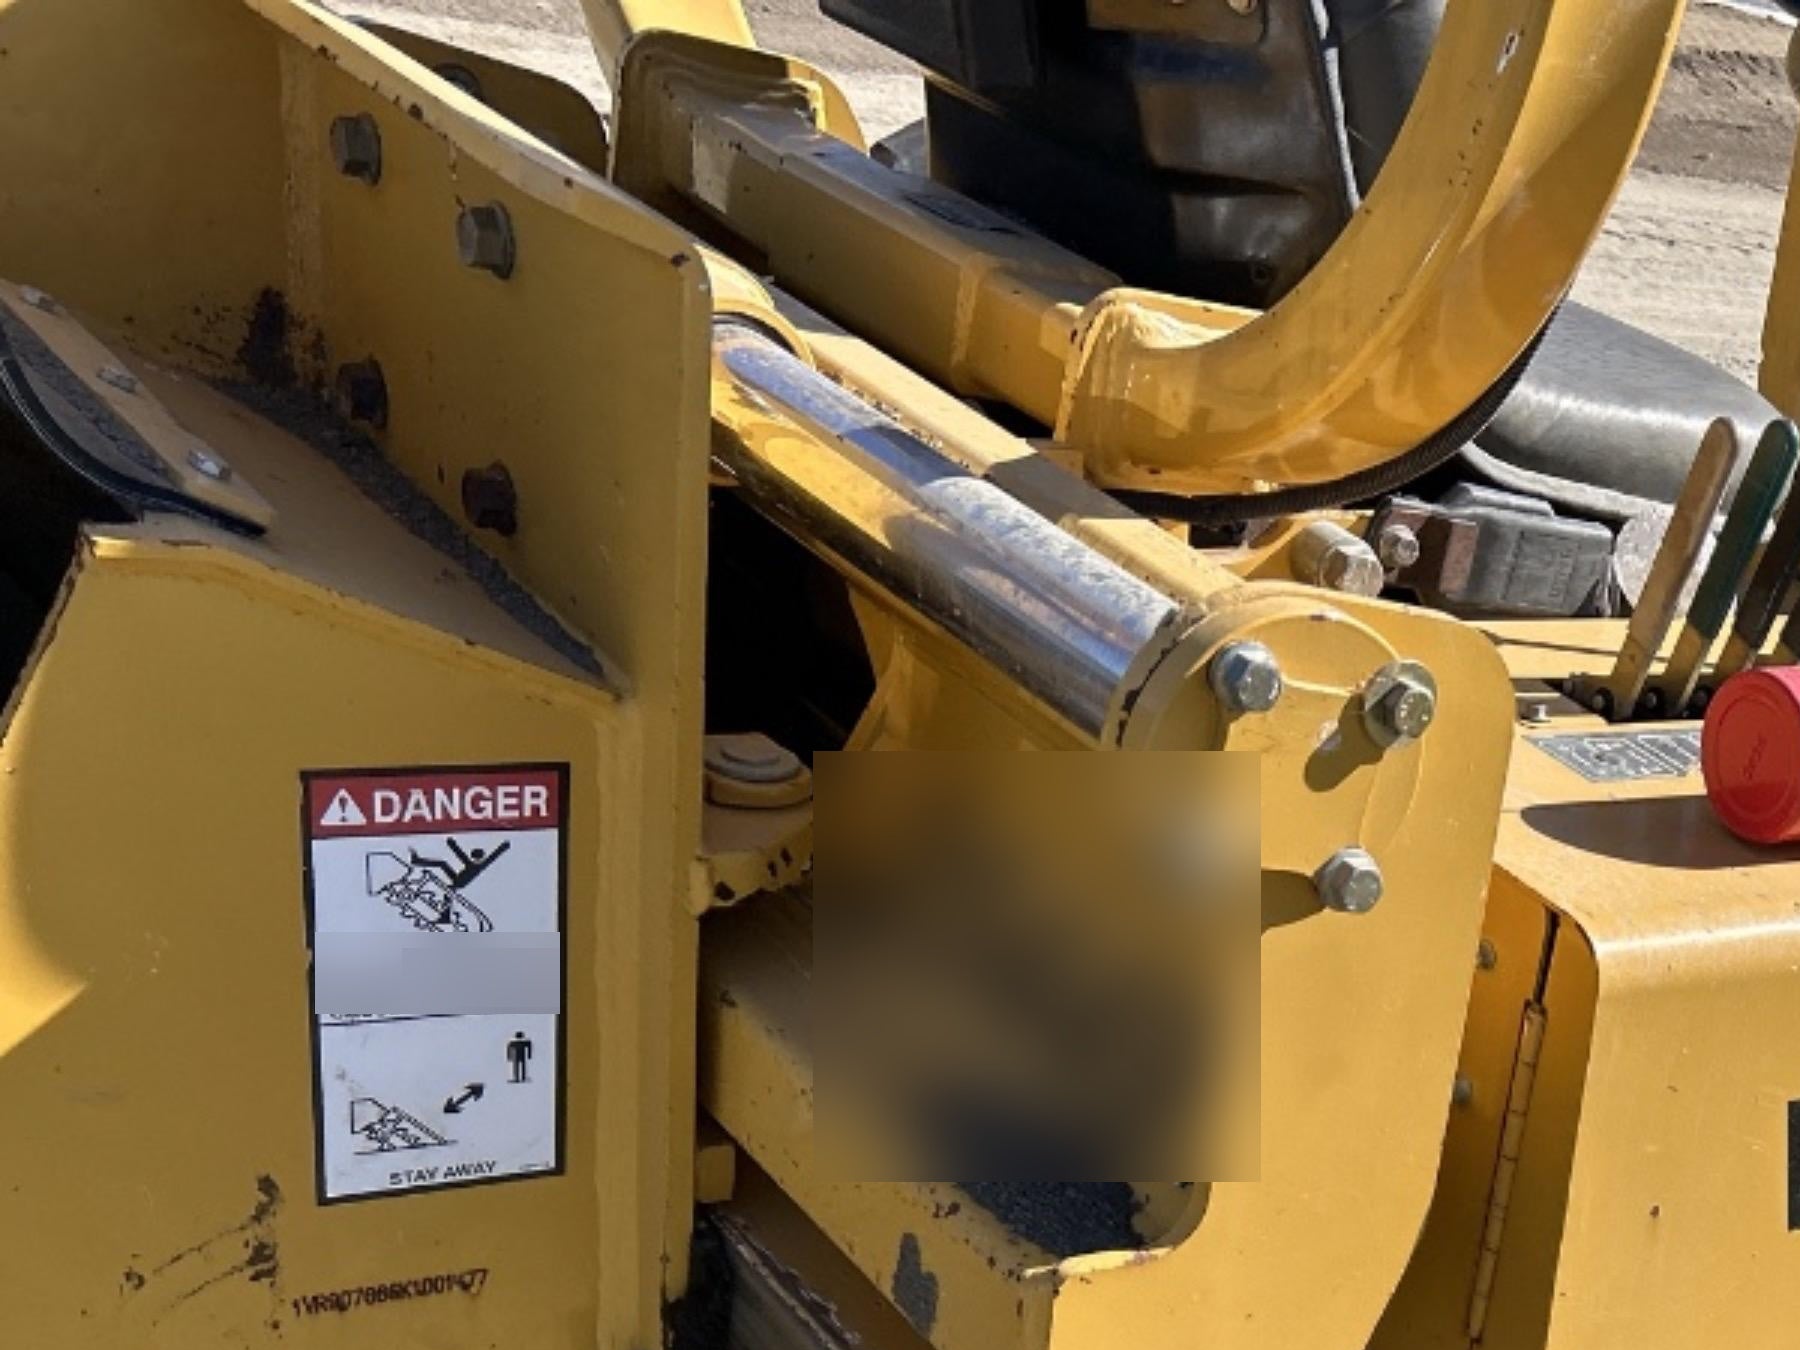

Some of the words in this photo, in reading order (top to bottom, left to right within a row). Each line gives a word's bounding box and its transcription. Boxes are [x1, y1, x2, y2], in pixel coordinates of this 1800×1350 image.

[372, 785, 549, 824] DANGER
[389, 1167, 438, 1186] STAY
[444, 1160, 497, 1179] AWAY
